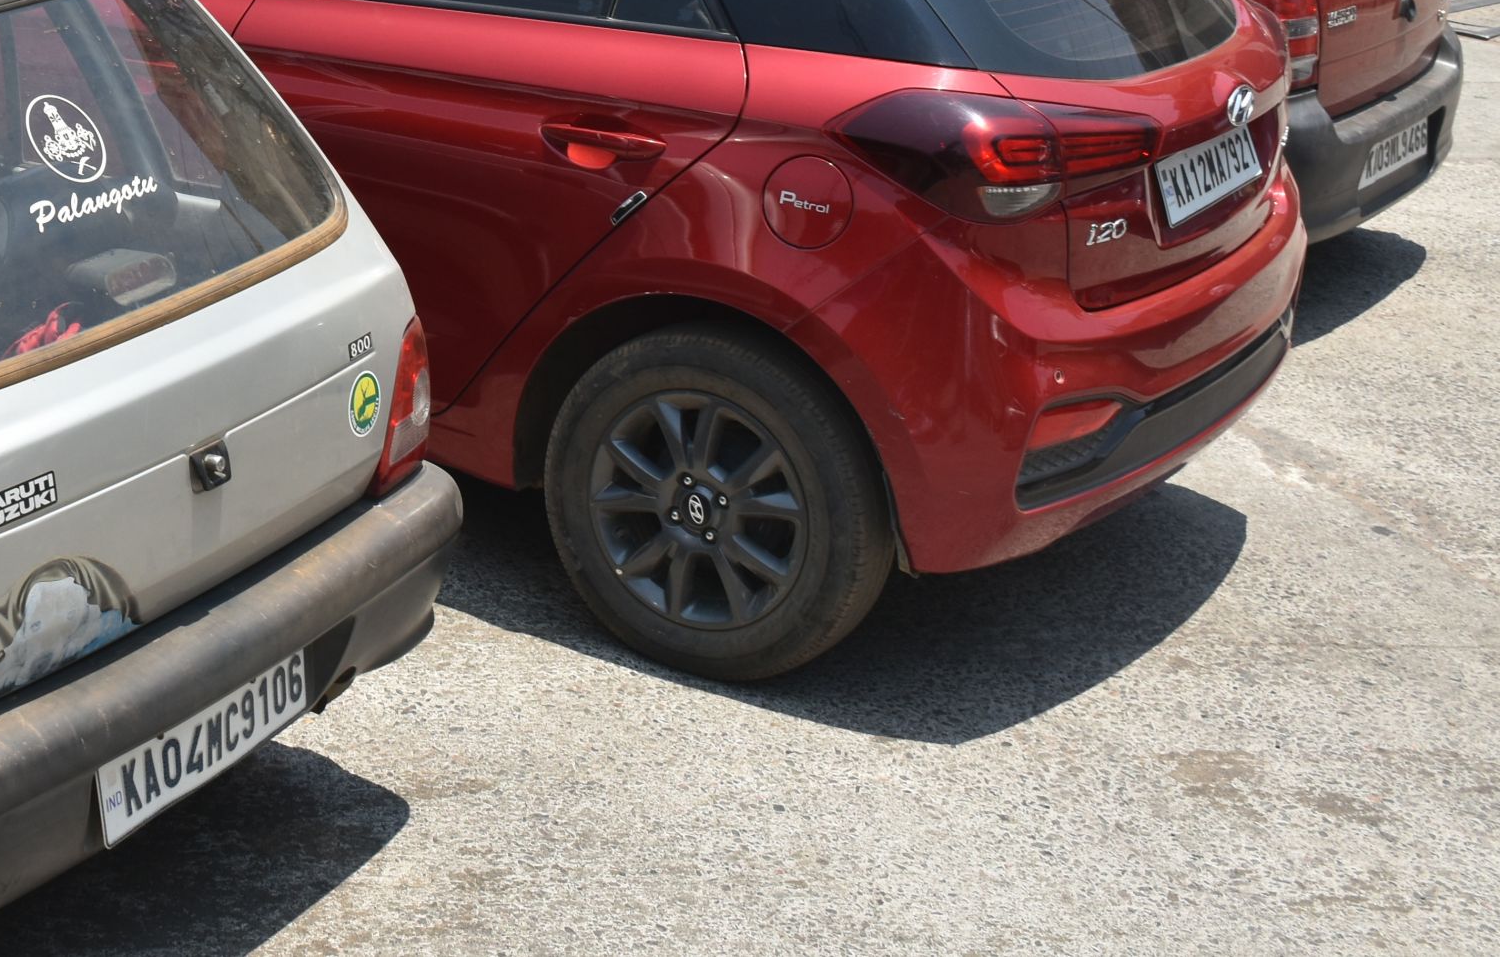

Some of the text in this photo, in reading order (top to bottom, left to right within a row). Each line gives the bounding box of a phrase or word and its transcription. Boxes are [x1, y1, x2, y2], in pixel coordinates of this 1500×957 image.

[1169, 128, 1256, 208] KA12MA7921
[30, 175, 158, 233] Palangotu
[779, 189, 830, 214] Petrol
[1086, 218, 1127, 245] i20
[350, 335, 371, 357] 800
[120, 653, 302, 818] KA04MC9106
[105, 789, 122, 813] IND
